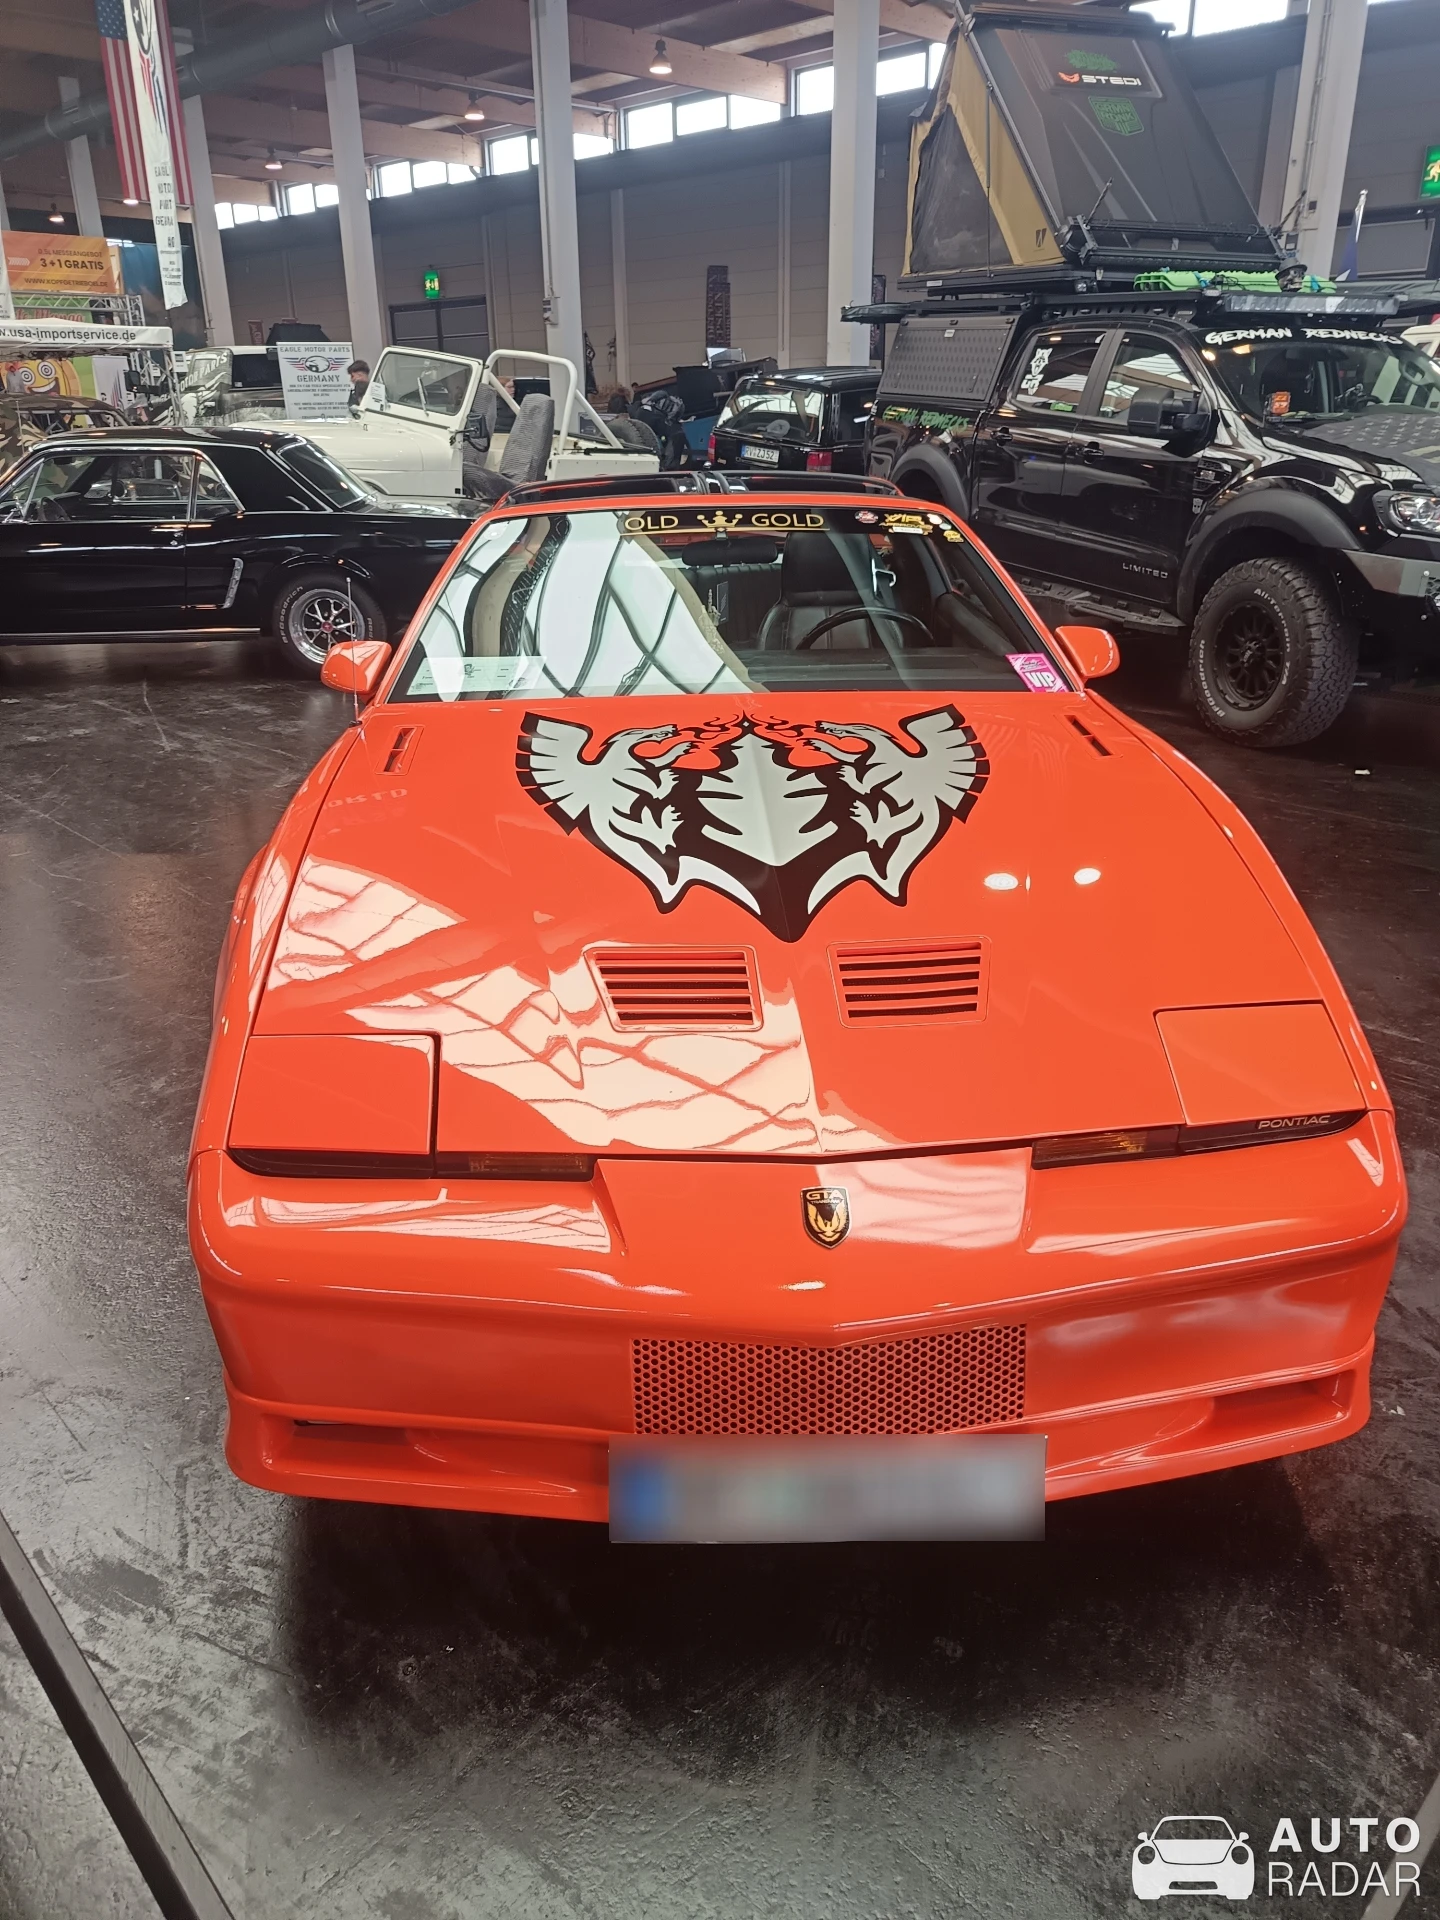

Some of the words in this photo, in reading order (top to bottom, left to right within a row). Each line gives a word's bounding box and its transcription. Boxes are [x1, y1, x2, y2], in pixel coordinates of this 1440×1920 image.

[1081, 75, 1142, 86] STEDI
[64, 259, 104, 270] GRATIS
[1205, 327, 1292, 345] GERMAN
[180, 370, 200, 392] OTOR
[297, 374, 340, 383] GERMANY
[624, 515, 679, 531] OLD
[751, 513, 825, 527] GOLD
[1122, 562, 1169, 578] LIMITED
[1024, 671, 1056, 687] VIP
[1199, 639, 1226, 718] BFGoodrich
[1258, 1115, 1330, 1129] PONTIAC
[806, 1189, 844, 1200] GTA
